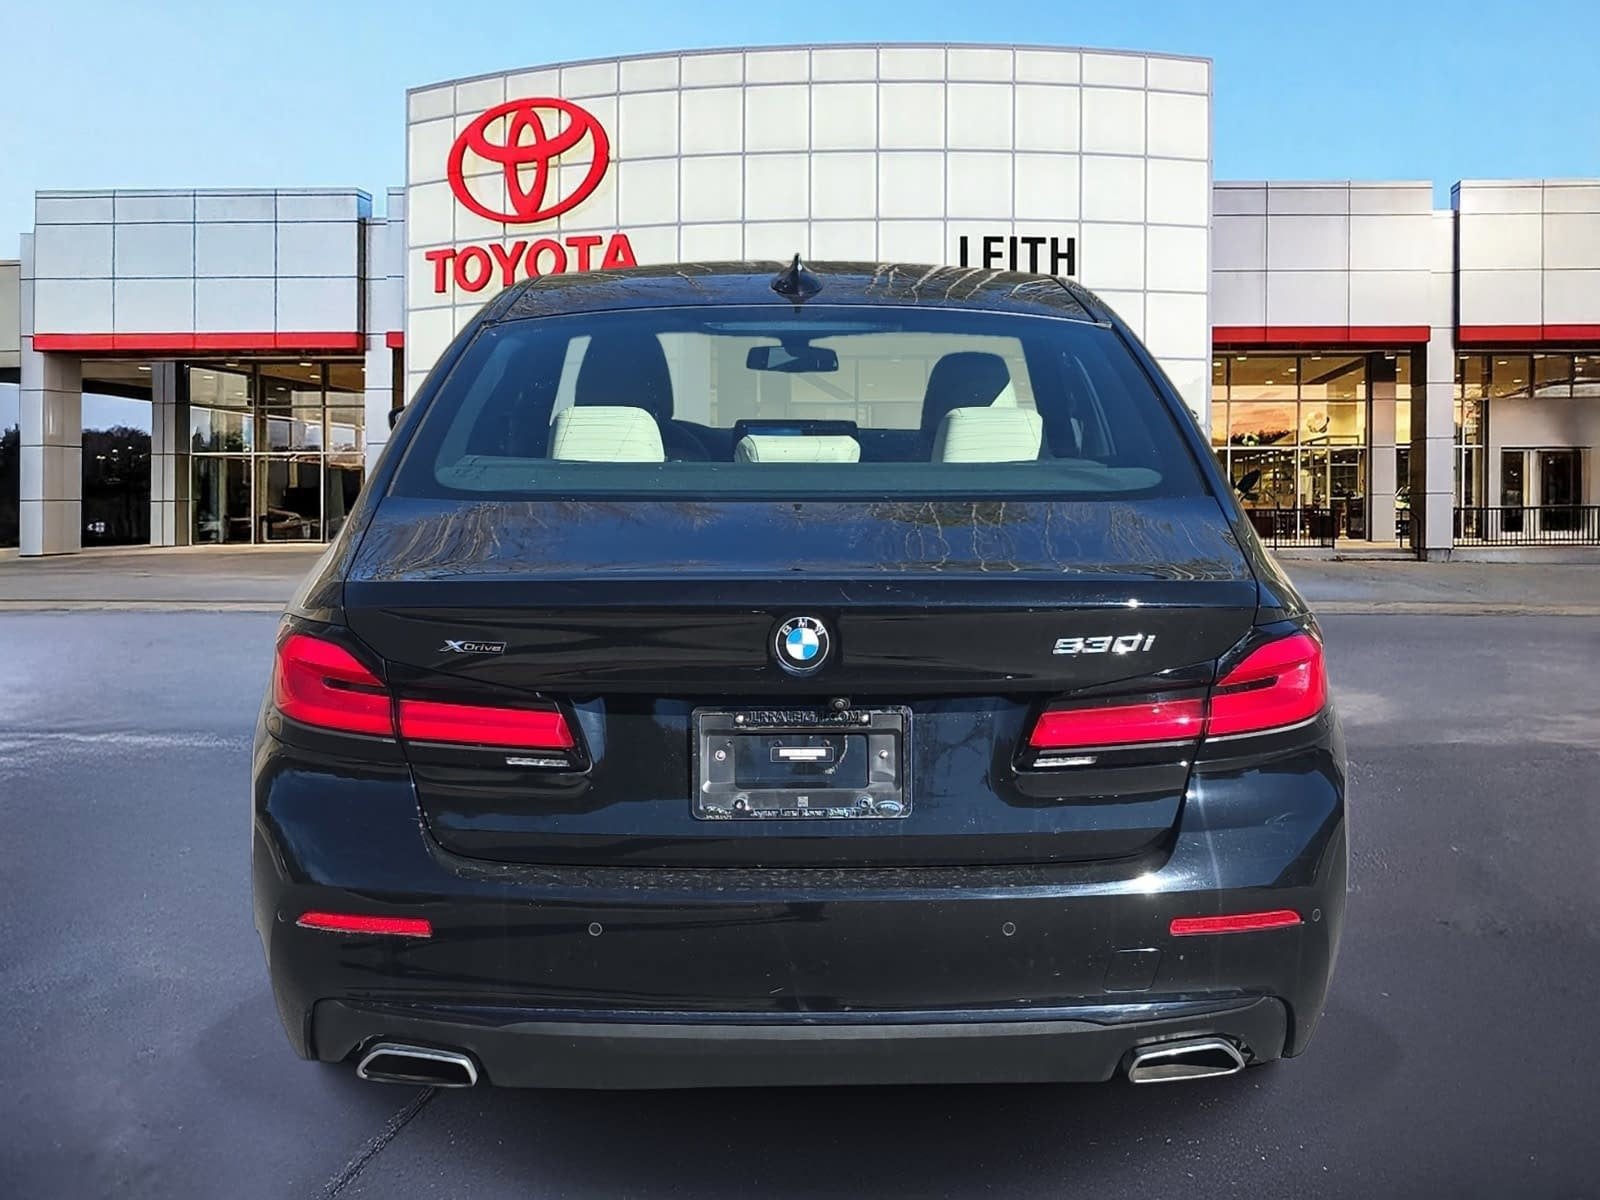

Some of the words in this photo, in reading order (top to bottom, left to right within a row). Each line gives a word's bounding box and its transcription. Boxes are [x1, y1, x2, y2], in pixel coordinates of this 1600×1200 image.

[425, 233, 638, 293] TOYOTA
[960, 236, 1075, 275] LEITH
[781, 617, 825, 636] BMW
[1052, 633, 1156, 655] 530i
